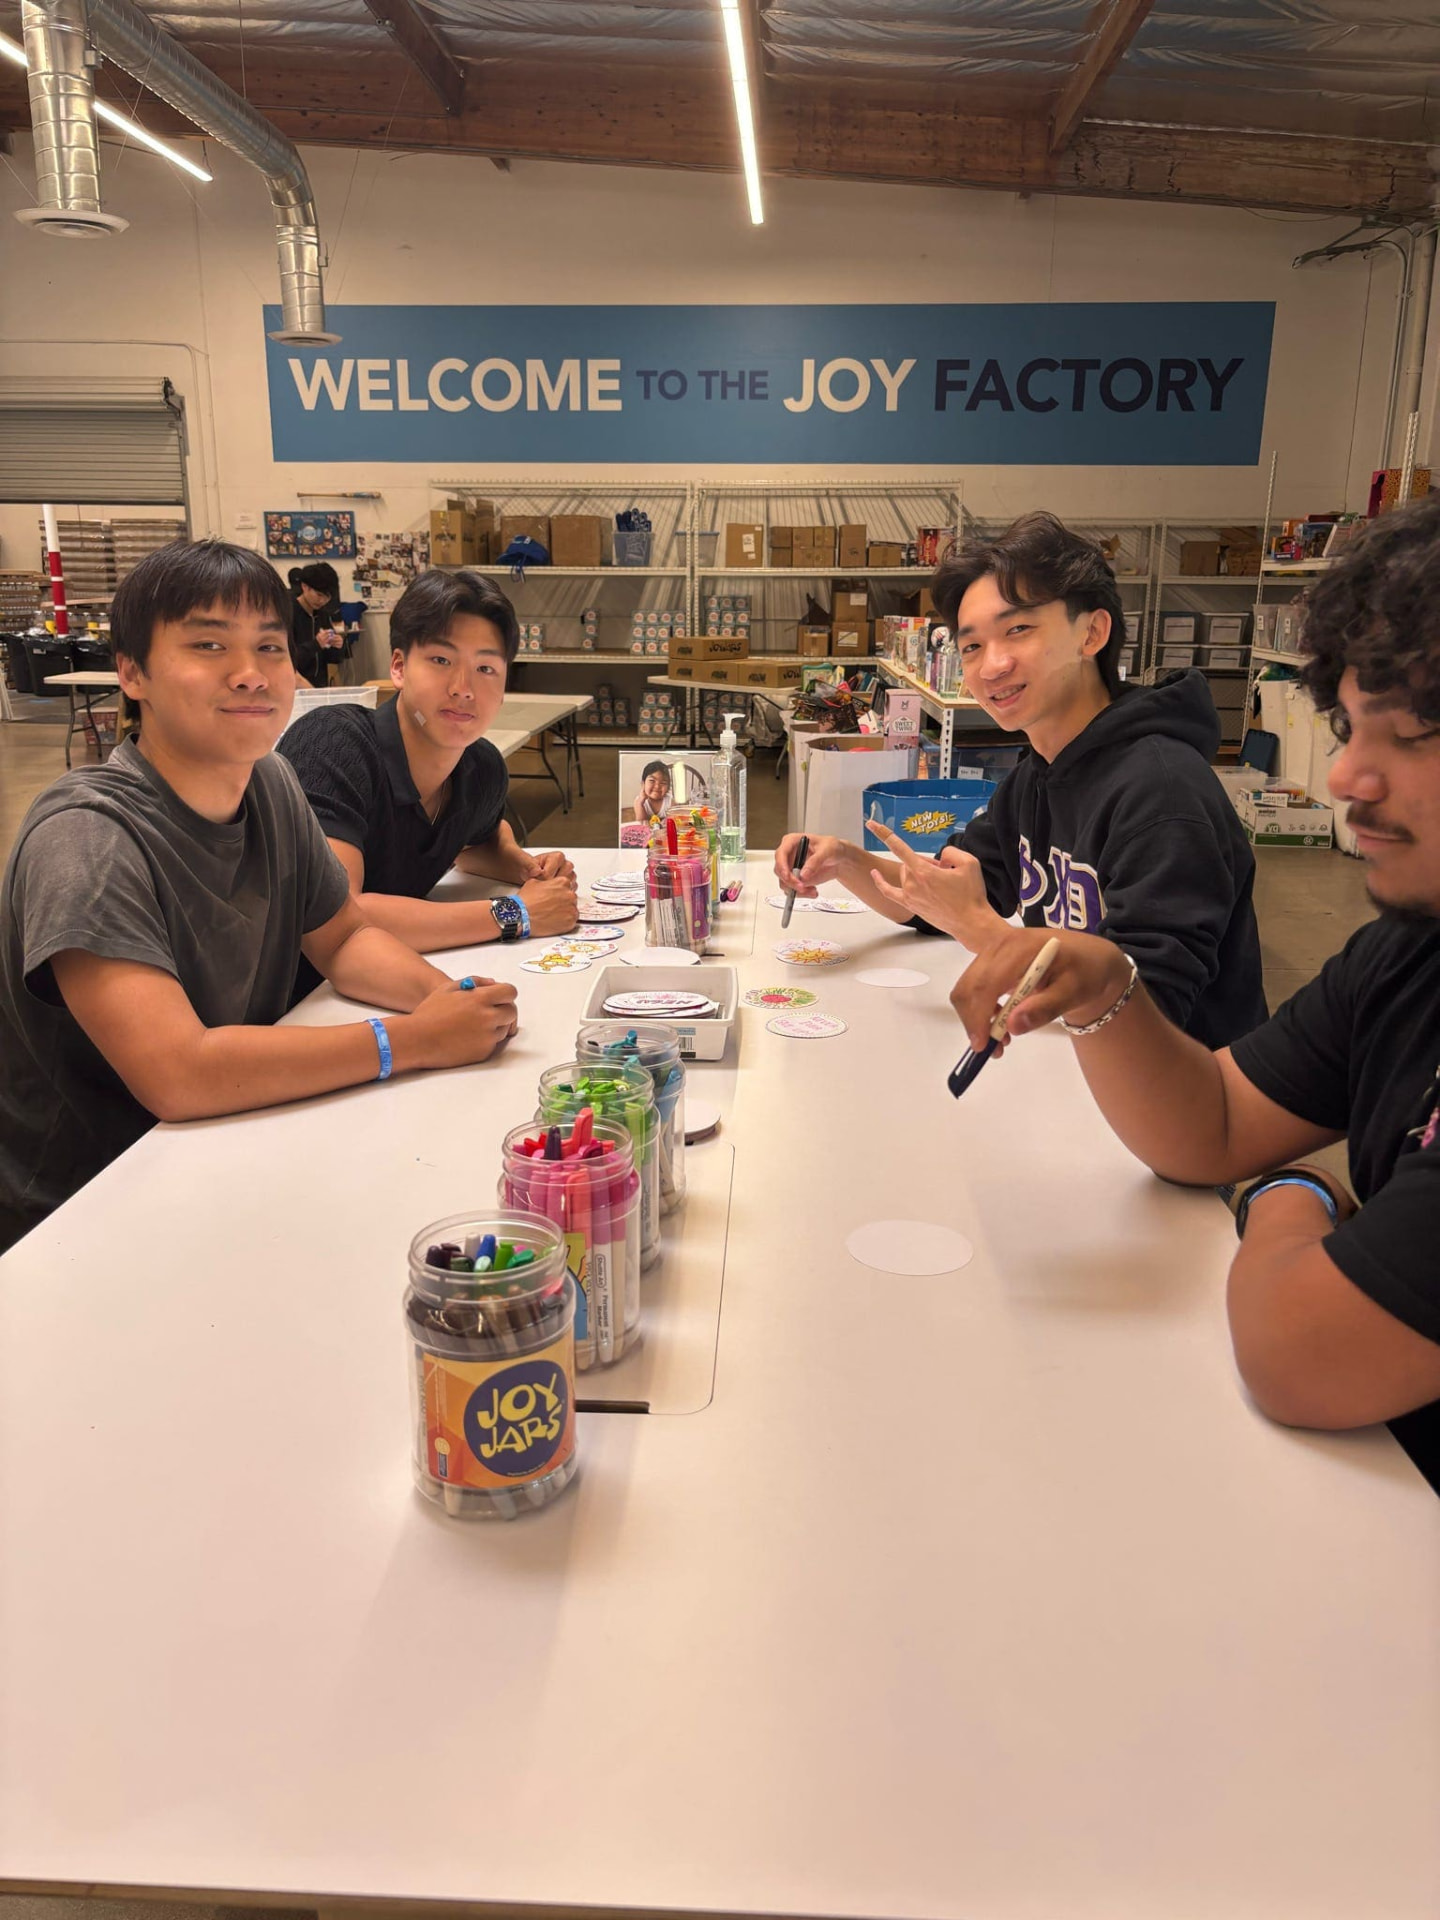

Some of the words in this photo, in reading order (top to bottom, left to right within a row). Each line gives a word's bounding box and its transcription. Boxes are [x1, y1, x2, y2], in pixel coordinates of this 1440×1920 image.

[288, 358, 622, 412] WELCOME
[636, 370, 688, 400] TO
[698, 370, 769, 400] THE
[783, 358, 916, 412] JOY
[934, 358, 1245, 412] FACTORY
[911, 811, 932, 828] NEW
[477, 1373, 557, 1429] JOY
[480, 1404, 562, 1458] JARS
